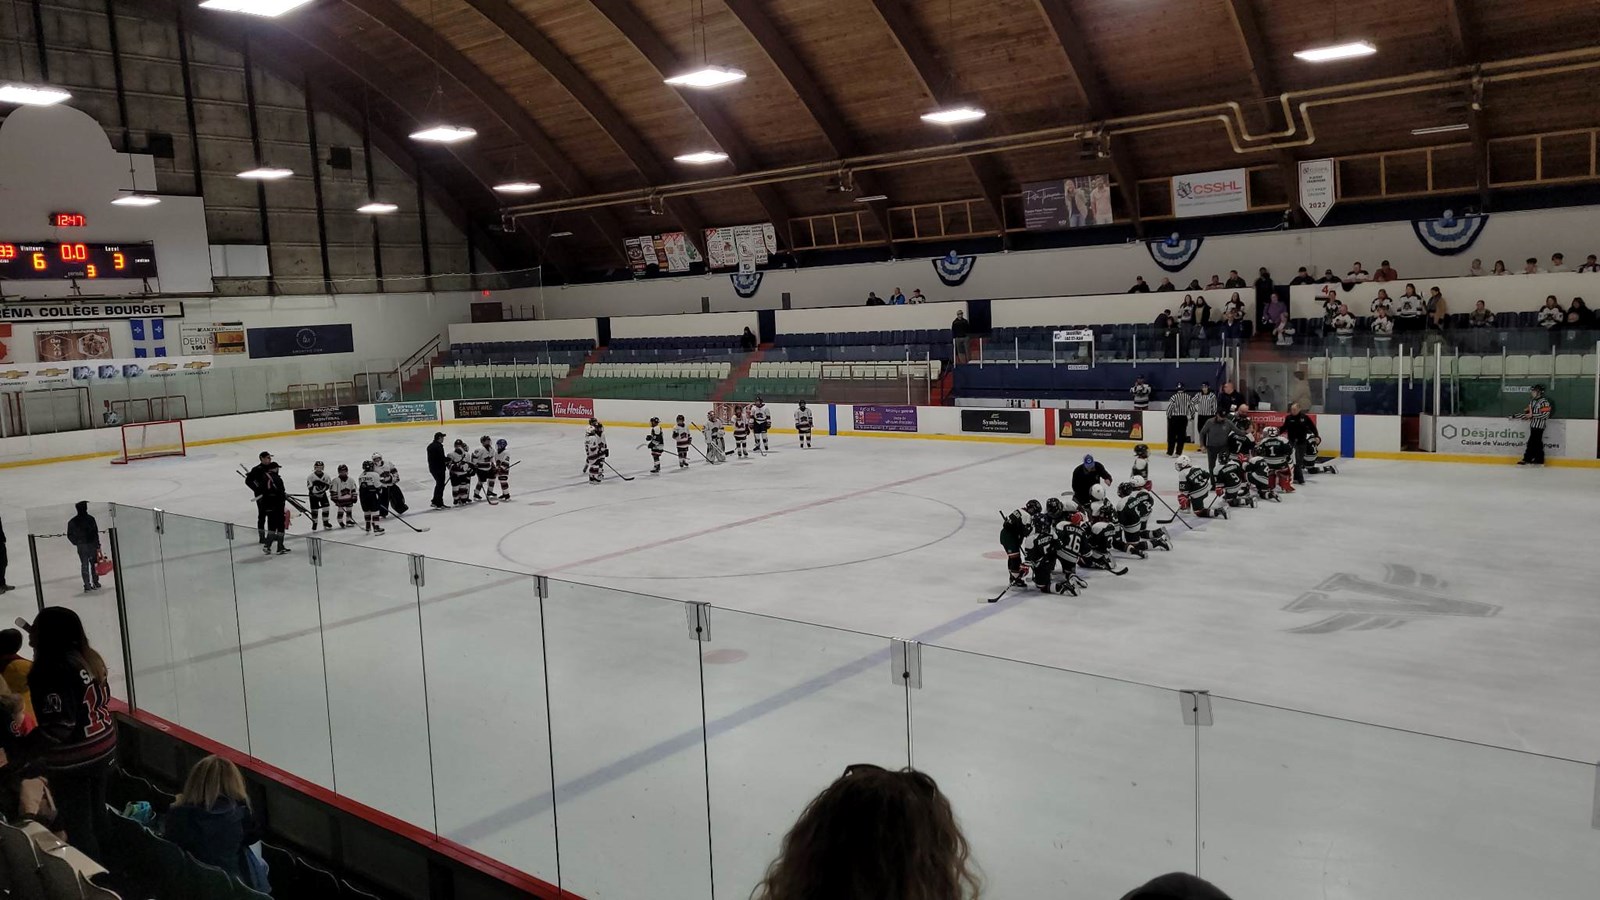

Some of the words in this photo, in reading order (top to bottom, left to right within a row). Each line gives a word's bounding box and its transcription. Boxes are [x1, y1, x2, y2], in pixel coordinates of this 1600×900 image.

[1193, 181, 1242, 195] CSSHL
[33, 253, 47, 270] 6
[113, 253, 124, 269] 3
[87, 265, 96, 277] 3
[0, 305, 34, 318] ÉNA
[39, 304, 100, 318] COLLÈGE
[105, 304, 166, 316] BOURGET
[183, 336, 214, 346] DEPUIS
[554, 402, 567, 415] Tim
[567, 402, 593, 416] Hortons
[1069, 412, 1088, 420] VOTRE
[1089, 413, 1132, 421] RENDEZ-VOUS
[982, 419, 1009, 427] Symbiose
[1075, 418, 1125, 428] D'APRÈS-MATCH!
[1461, 428, 1526, 440] Desjardins
[1269, 446, 1276, 457] 1
[1229, 472, 1240, 483] 9
[1065, 534, 1081, 555] 16
